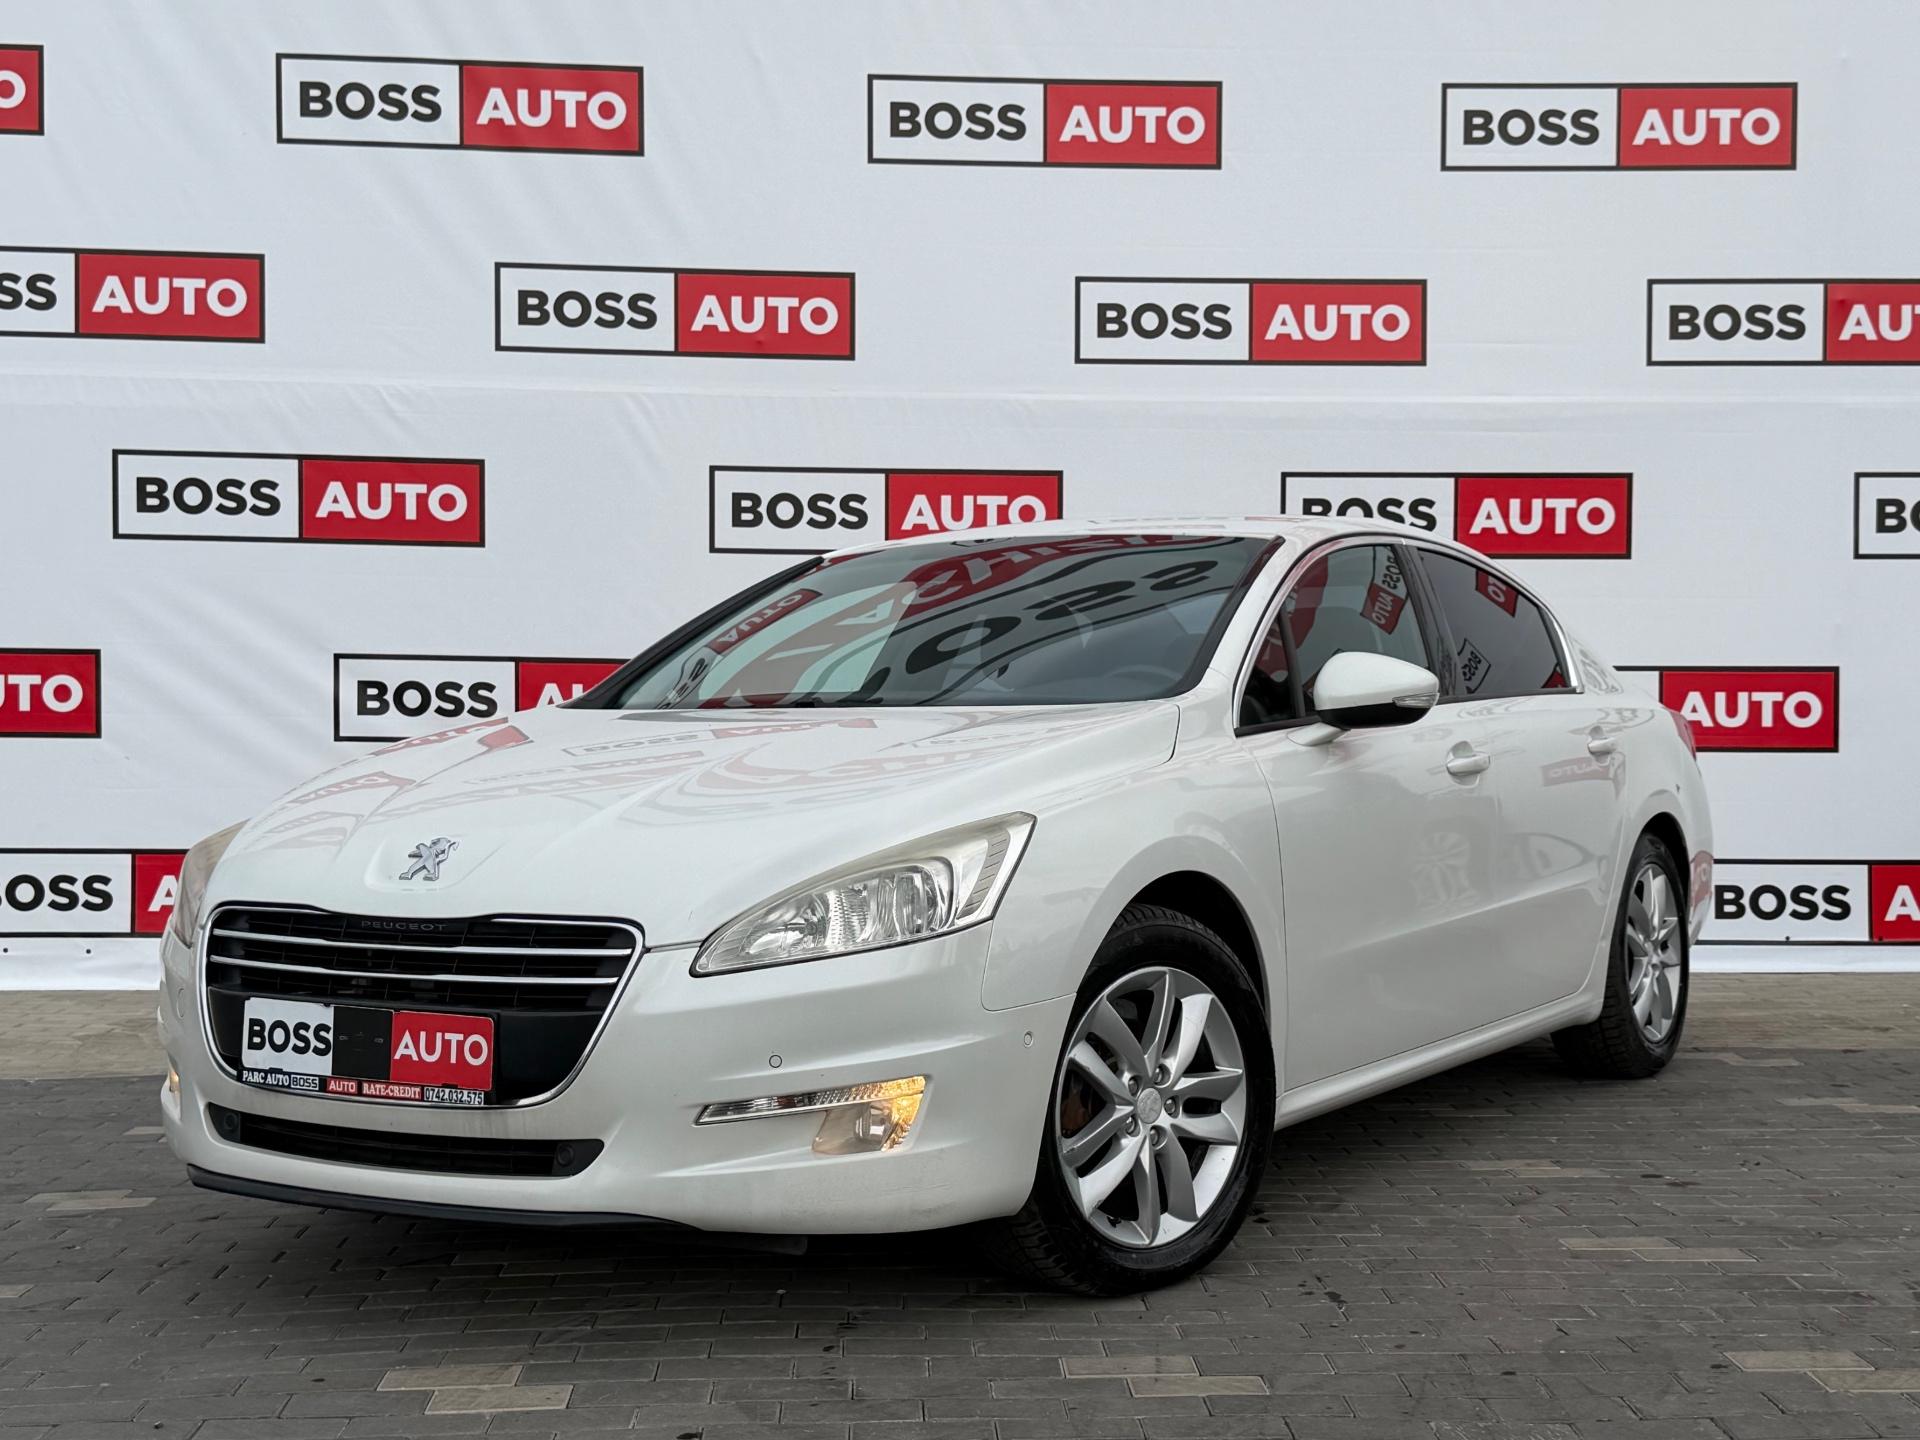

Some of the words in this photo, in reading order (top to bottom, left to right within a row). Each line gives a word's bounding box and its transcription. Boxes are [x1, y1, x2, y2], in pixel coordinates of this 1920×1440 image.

[299, 81, 442, 123] BOSS
[476, 87, 627, 130] AUTO
[889, 101, 1027, 141] BOSS
[1059, 104, 1206, 145] AUTO
[1463, 109, 1600, 146] BOSS
[1632, 107, 1781, 146] AUTO
[91, 275, 248, 317] AUTO
[517, 289, 658, 330] BOSS
[690, 294, 839, 335] AUTO
[1097, 302, 1232, 340] BOSS
[1264, 303, 1411, 342] AUTO
[1669, 304, 1806, 341] BOSS
[1838, 303, 1920, 341] AU
[136, 476, 281, 517] BOSS
[315, 481, 468, 522] AUTO
[731, 492, 869, 530] BOSS
[900, 494, 1047, 531] AUTO
[1469, 497, 1616, 535] AUTO
[1875, 498, 1920, 534] B
[0, 674, 83, 713] TO
[356, 679, 498, 719] BOSS
[1679, 691, 1824, 729] AUTO
[0, 874, 114, 912] OSS
[1714, 884, 1852, 921] BOSS
[361, 920, 448, 931] PEUGEOT
[248, 1018, 332, 1057] BOSS
[393, 1029, 488, 1066] AUTO
[242, 1070, 265, 1083] PARC
[265, 1073, 290, 1086] AUTO
[290, 1077, 319, 1089] BOSS
[328, 1080, 356, 1093] AUTO
[362, 1082, 421, 1099] RATE-CREDIT
